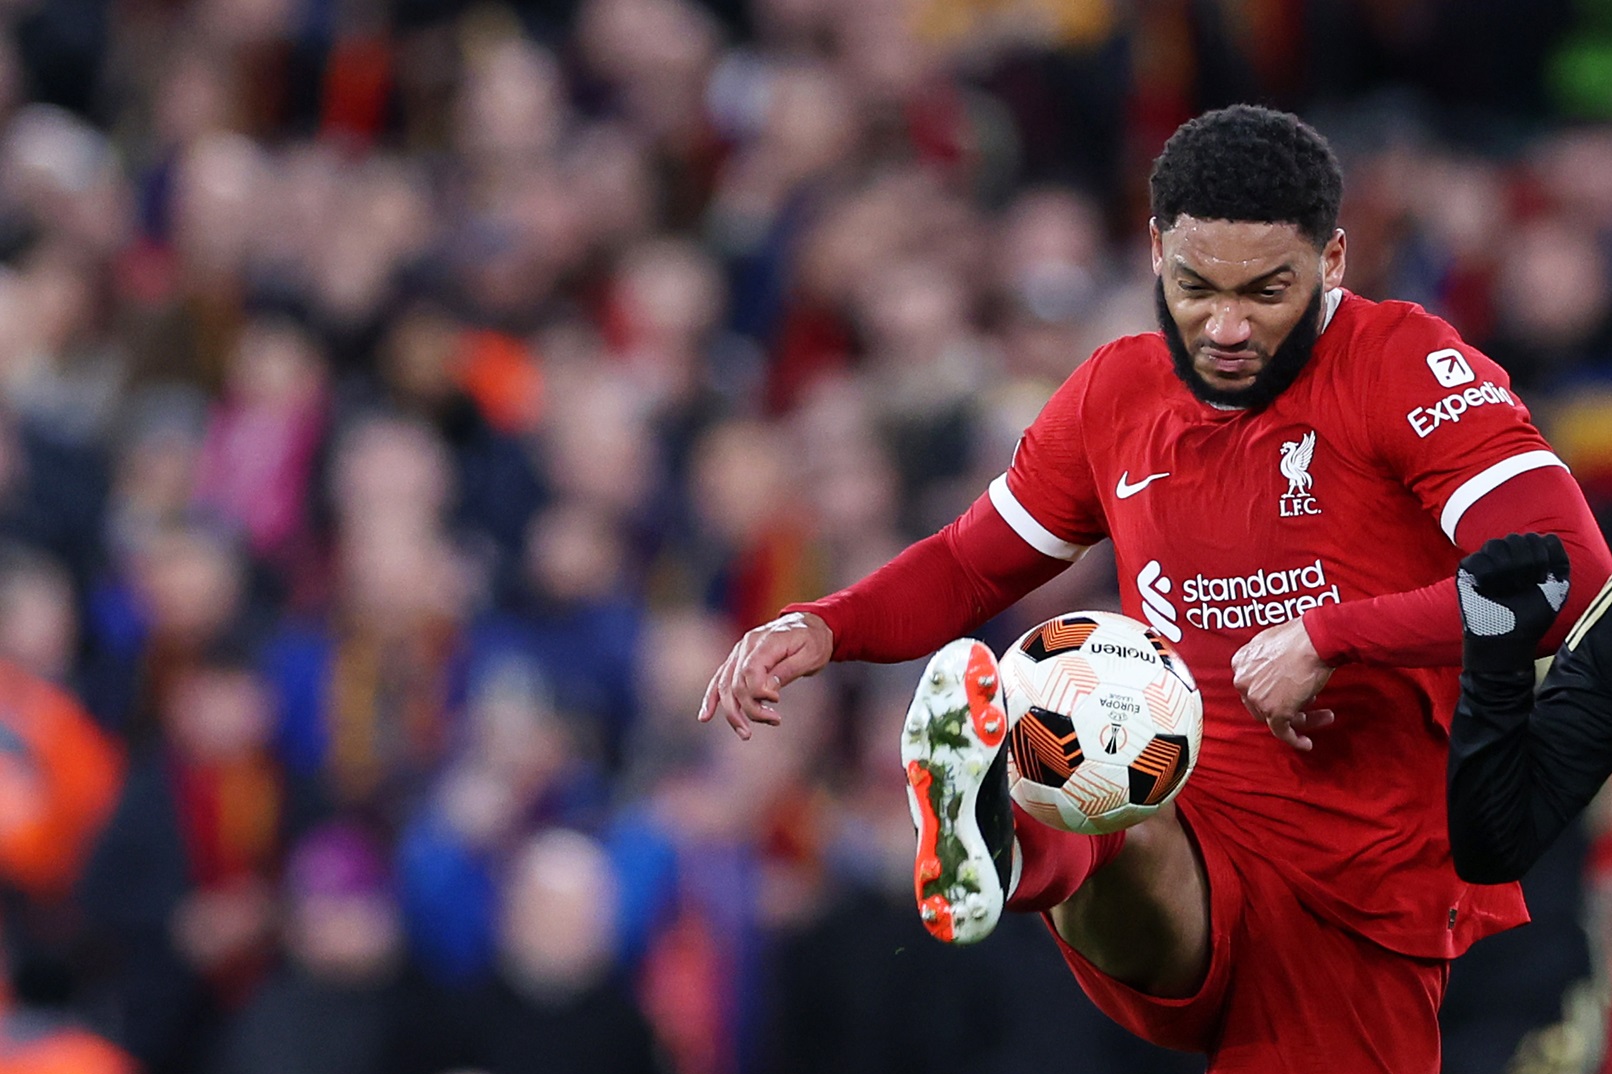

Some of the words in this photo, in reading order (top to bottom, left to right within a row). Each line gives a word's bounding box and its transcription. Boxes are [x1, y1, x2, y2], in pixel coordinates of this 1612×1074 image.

[1279, 498, 1322, 517] L.F.C.
[1182, 558, 1326, 602] standard
[1186, 584, 1340, 630] chartered
[1091, 643, 1156, 664] molten
[1099, 698, 1141, 714] EUROPA
